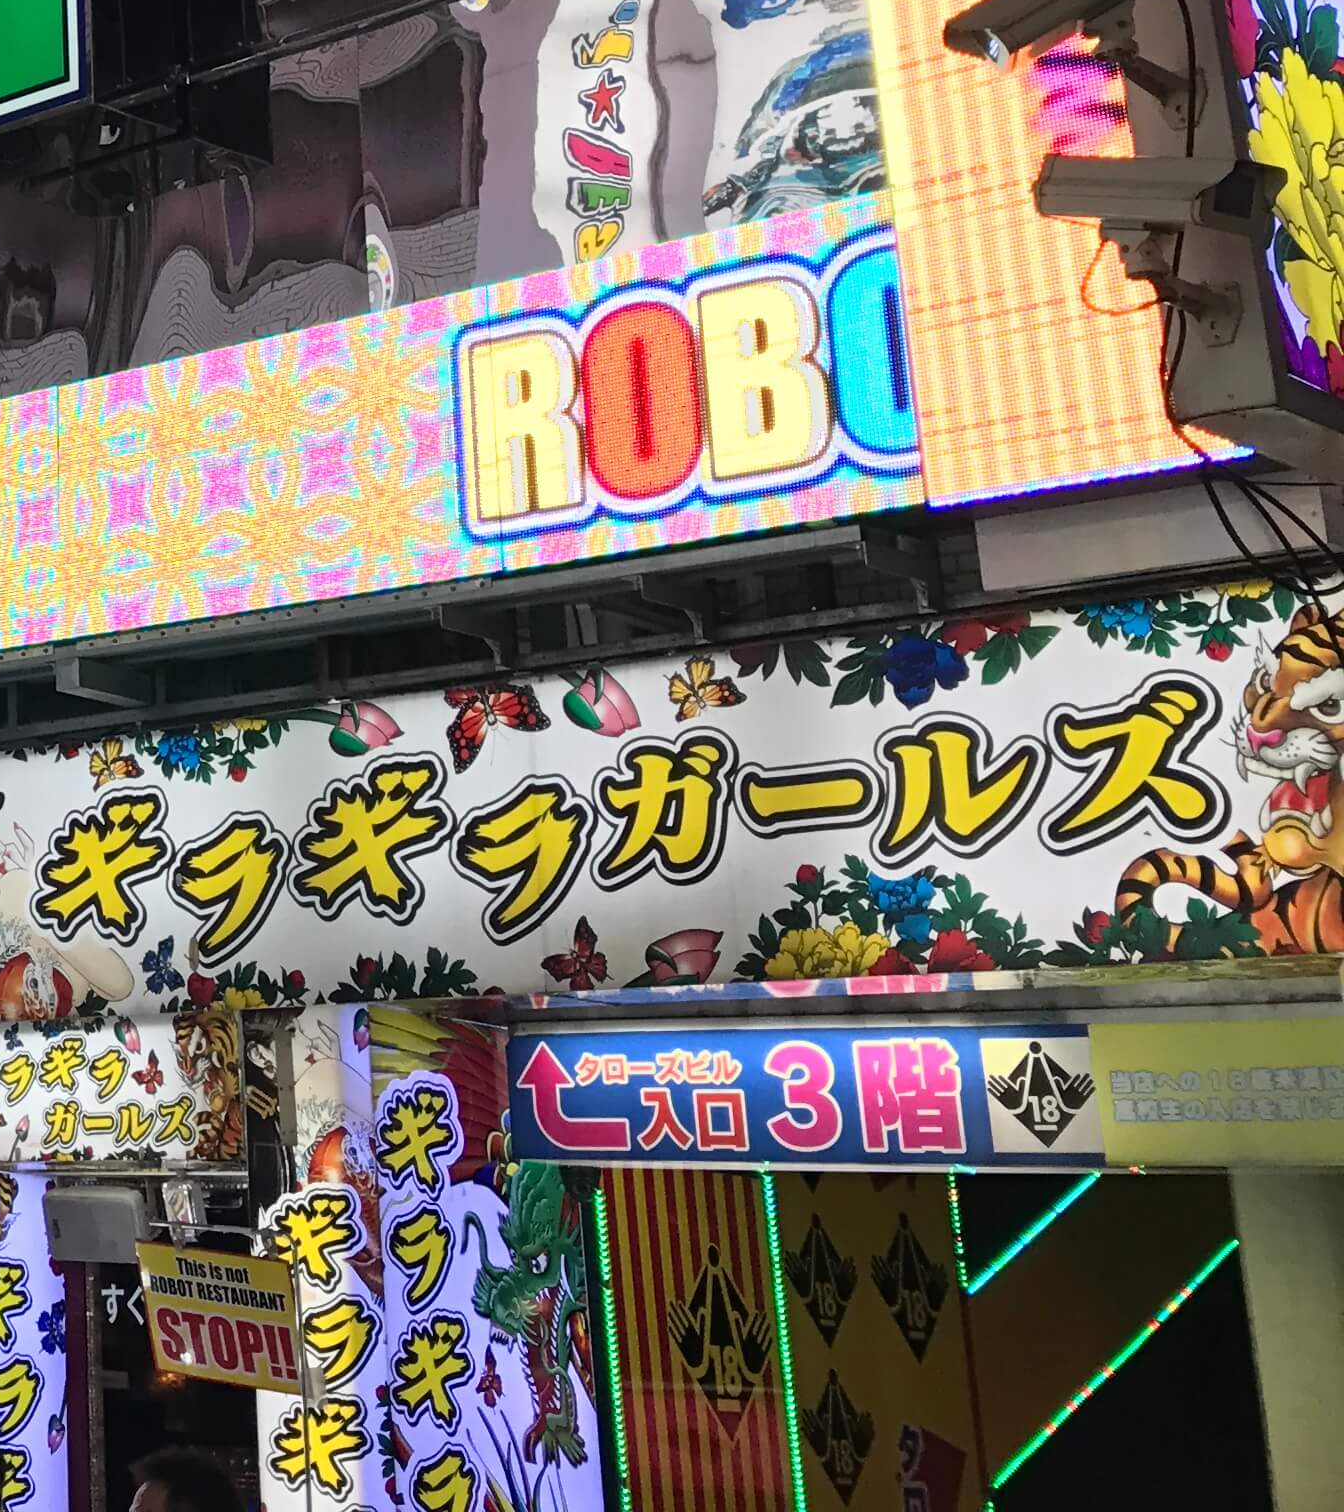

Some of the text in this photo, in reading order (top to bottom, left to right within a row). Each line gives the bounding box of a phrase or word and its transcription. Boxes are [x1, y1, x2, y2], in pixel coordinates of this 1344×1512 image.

[32, 671, 1230, 968] ギラギラガールズ
[573, 1048, 740, 1086] タローズビル
[764, 1036, 968, 1155] 3階
[41, 1094, 197, 1151] ガールズ
[638, 1087, 749, 1153] 入口
[1028, 1095, 1060, 1124] 18
[150, 1274, 287, 1313] ROBOT RESTAURANT
[175, 1256, 250, 1285] This is not
[156, 1306, 299, 1381] STOP!!
